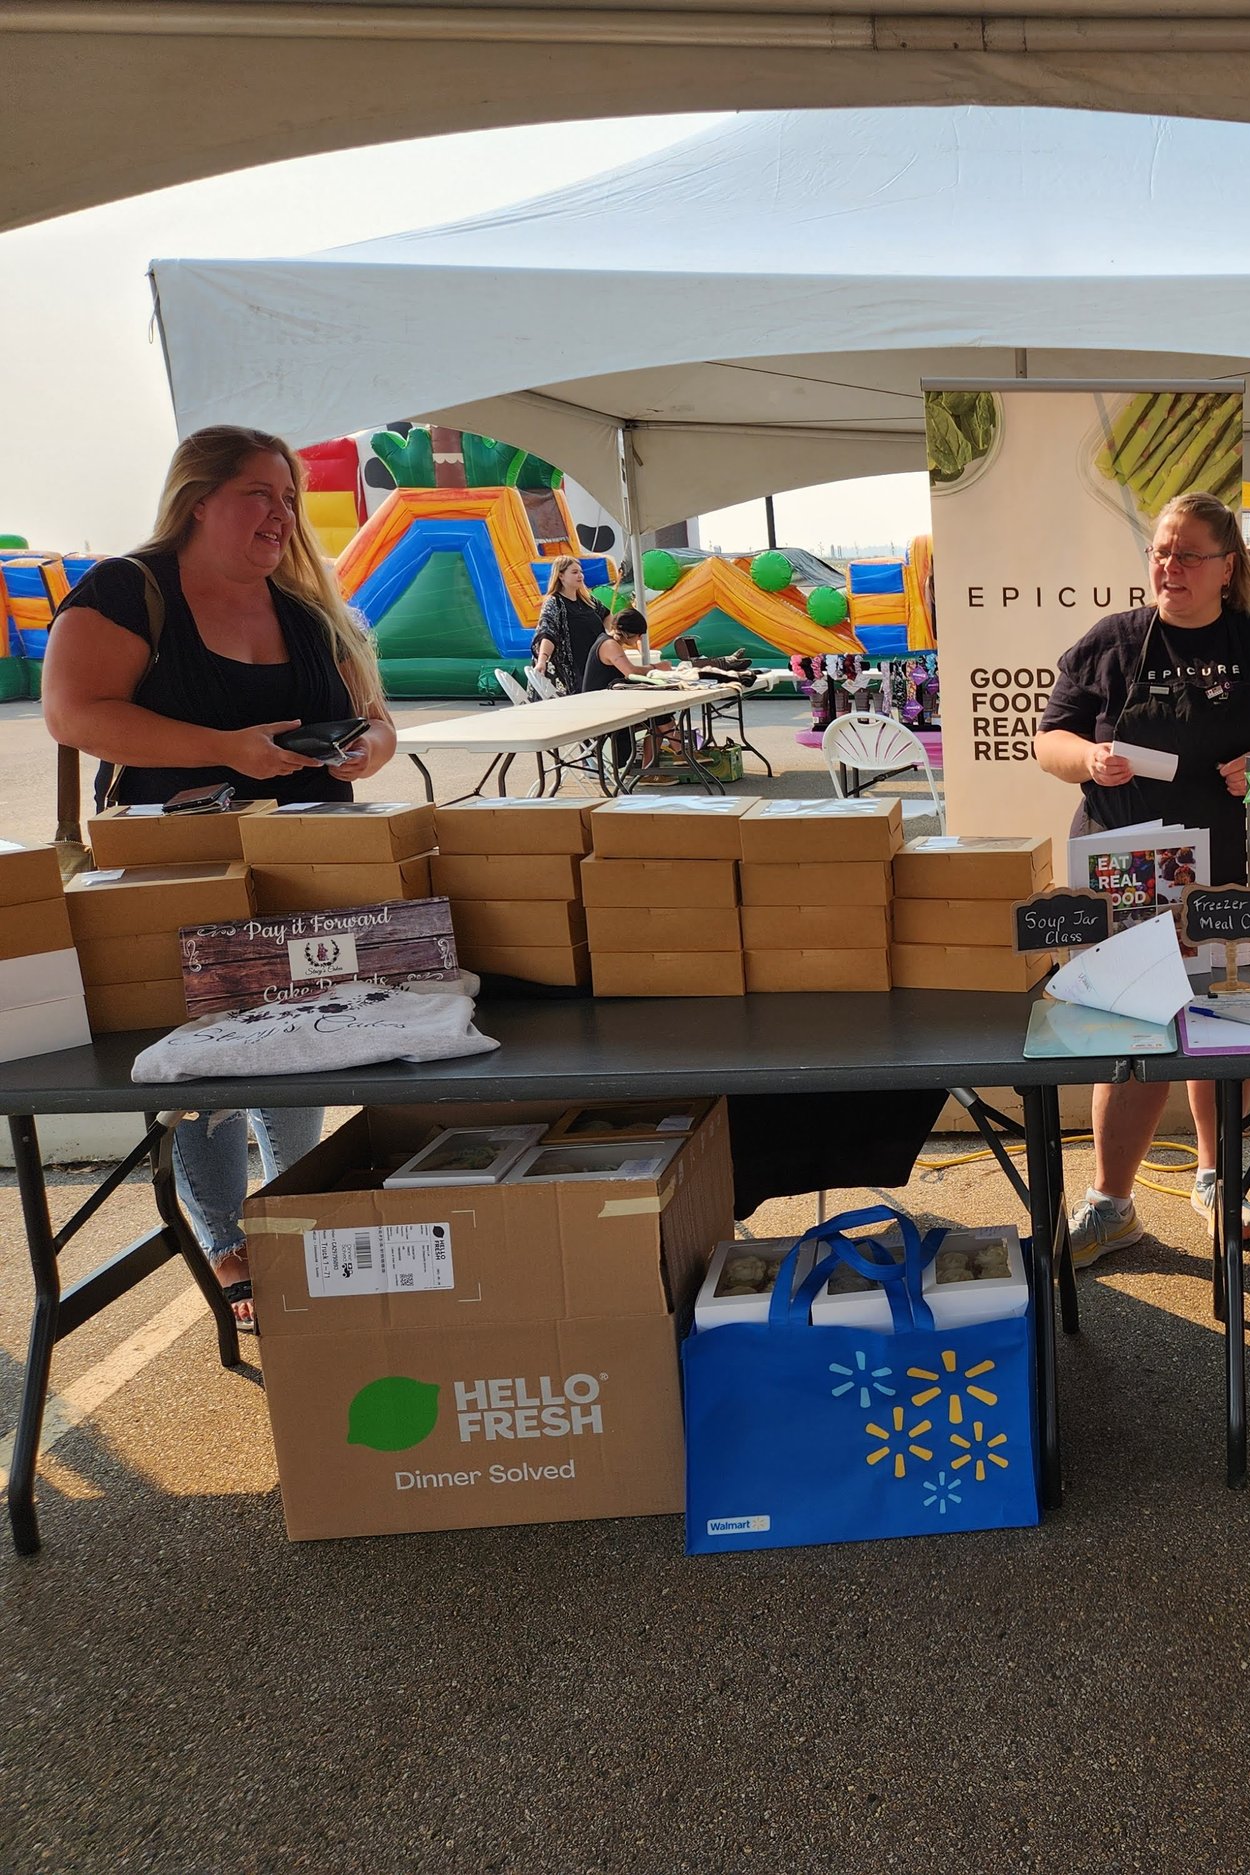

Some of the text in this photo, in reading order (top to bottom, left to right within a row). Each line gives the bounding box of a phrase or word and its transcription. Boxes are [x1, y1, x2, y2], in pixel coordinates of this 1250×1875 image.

[967, 586, 1147, 608] EPICUR
[970, 667, 1056, 689] GOOD
[1147, 664, 1241, 680] EPICURE
[972, 692, 1051, 713] FOOD
[1098, 855, 1130, 871] EAT
[1099, 873, 1143, 889] REAL
[1112, 890, 1147, 906] OOD
[1193, 894, 1248, 912] Freezer
[243, 906, 393, 945] Pay it Forward
[1025, 910, 1099, 932] Soup Jar
[1200, 915, 1234, 930] Meal
[1045, 931, 1082, 945] Class
[263, 981, 310, 1003] Cake
[453, 1373, 600, 1411] HELLO
[457, 1405, 603, 1443] FRESH
[395, 1459, 576, 1490] Dinner Solved
[710, 1520, 751, 1531] Walmart
